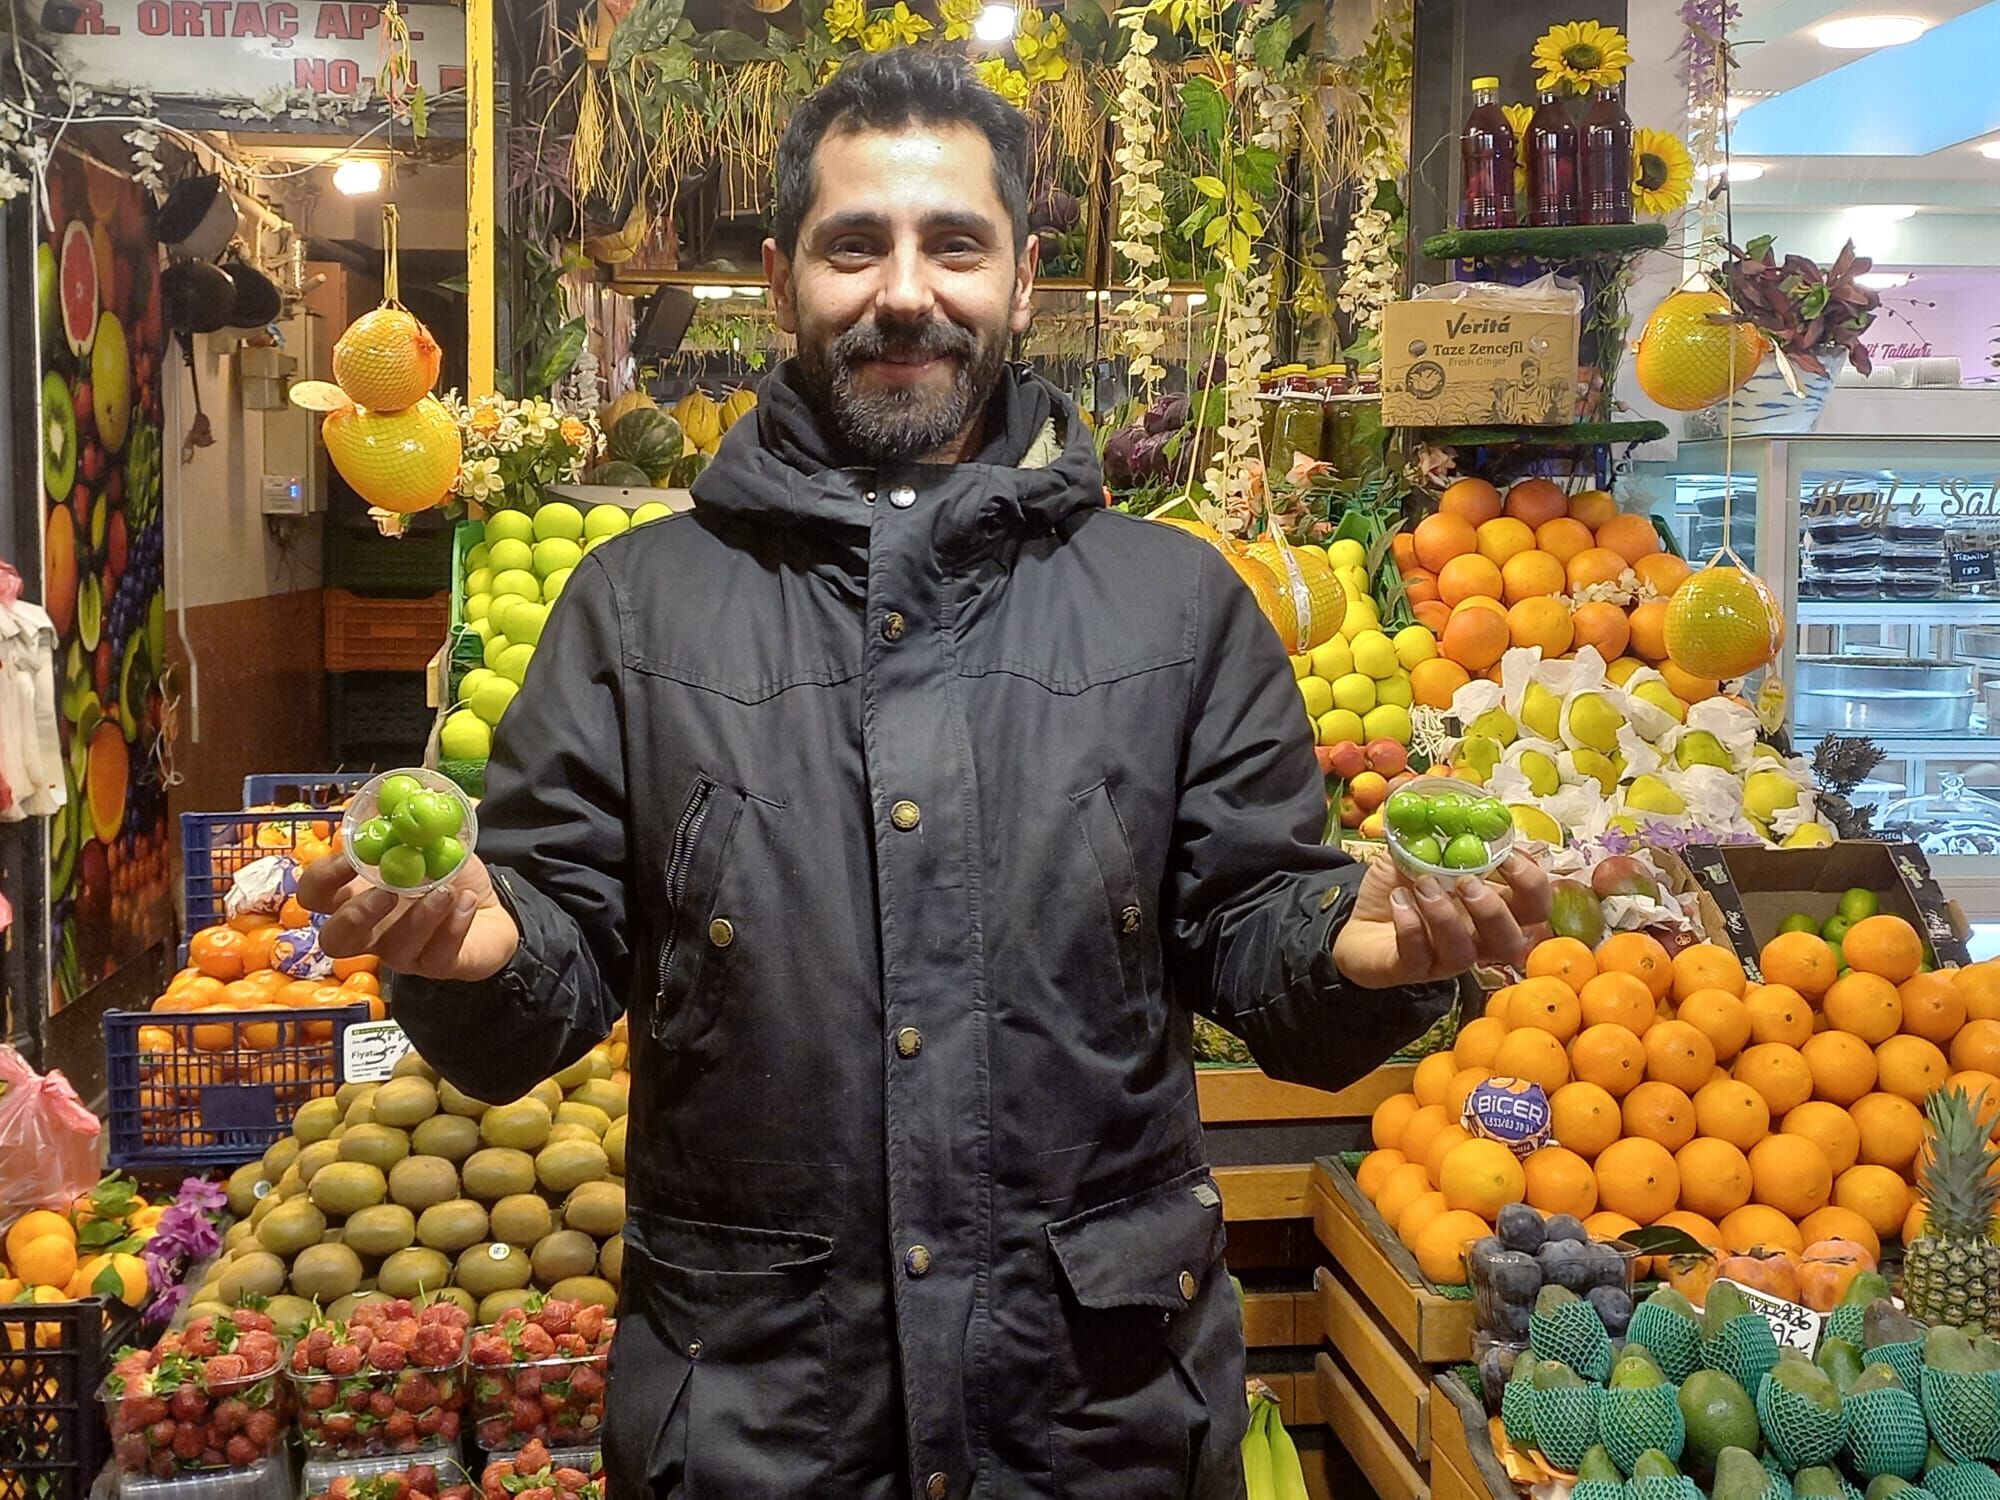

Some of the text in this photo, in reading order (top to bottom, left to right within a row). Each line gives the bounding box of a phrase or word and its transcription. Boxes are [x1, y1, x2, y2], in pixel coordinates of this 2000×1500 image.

[138, 1, 299, 48] ORTAÇ
[1433, 341, 1523, 357] Taze Zencefil
[1449, 357, 1507, 368] Fresh Ginger
[1940, 477, 2000, 517] Sal
